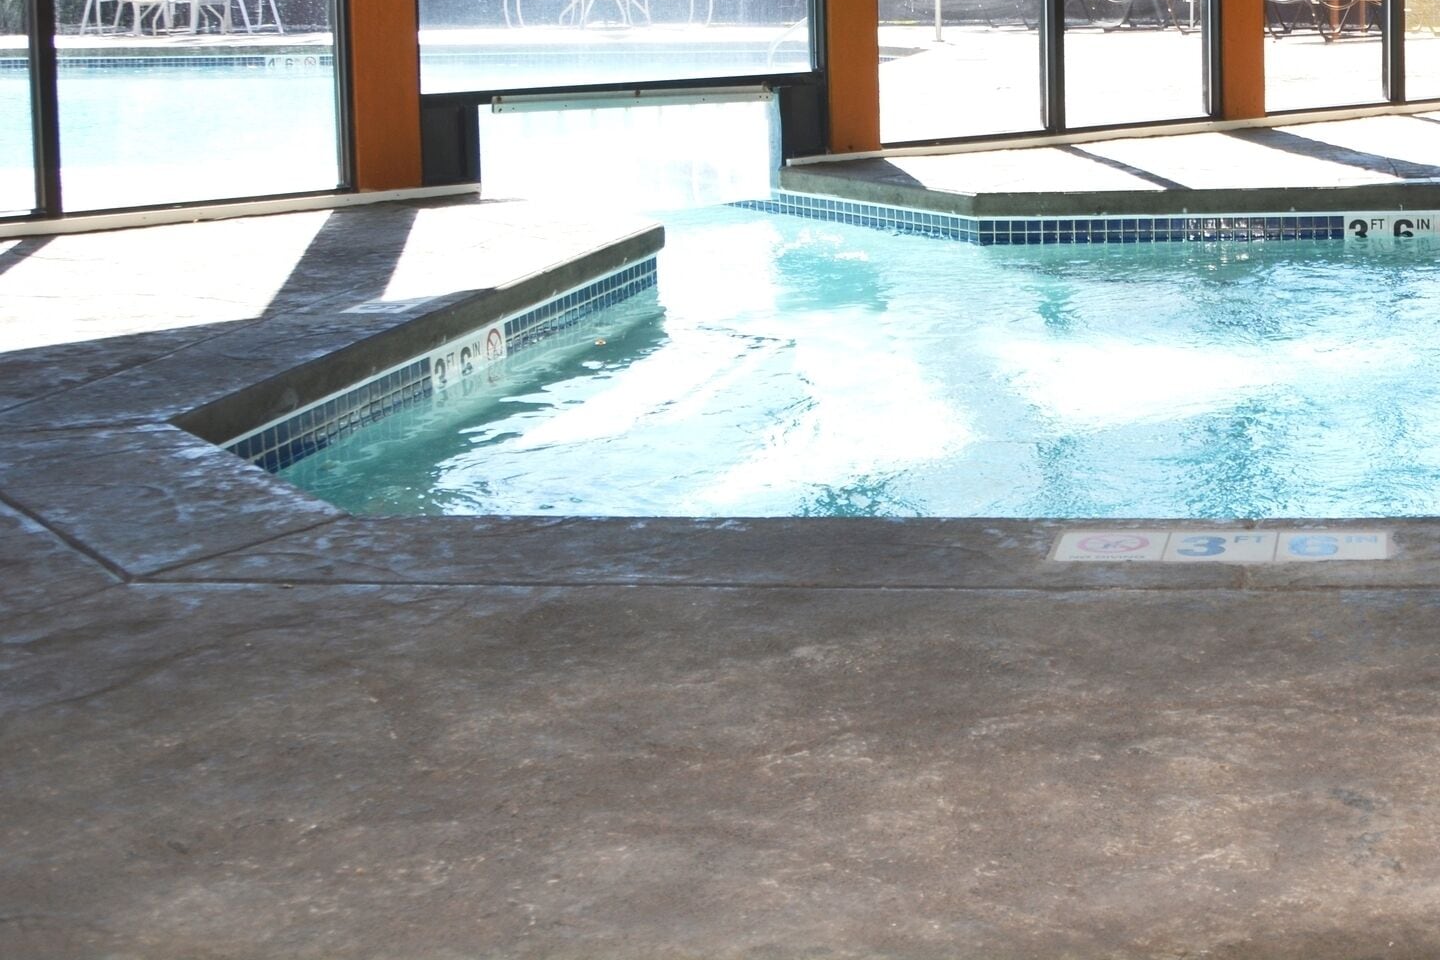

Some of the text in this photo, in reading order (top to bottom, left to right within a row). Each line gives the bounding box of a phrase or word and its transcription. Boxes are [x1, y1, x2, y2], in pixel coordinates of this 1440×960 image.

[1349, 219, 1430, 238] 3 FT 6 IN
[447, 352, 455, 367] FT
[473, 341, 481, 357] IN
[1177, 535, 1378, 556] 3 FT 6 IN
